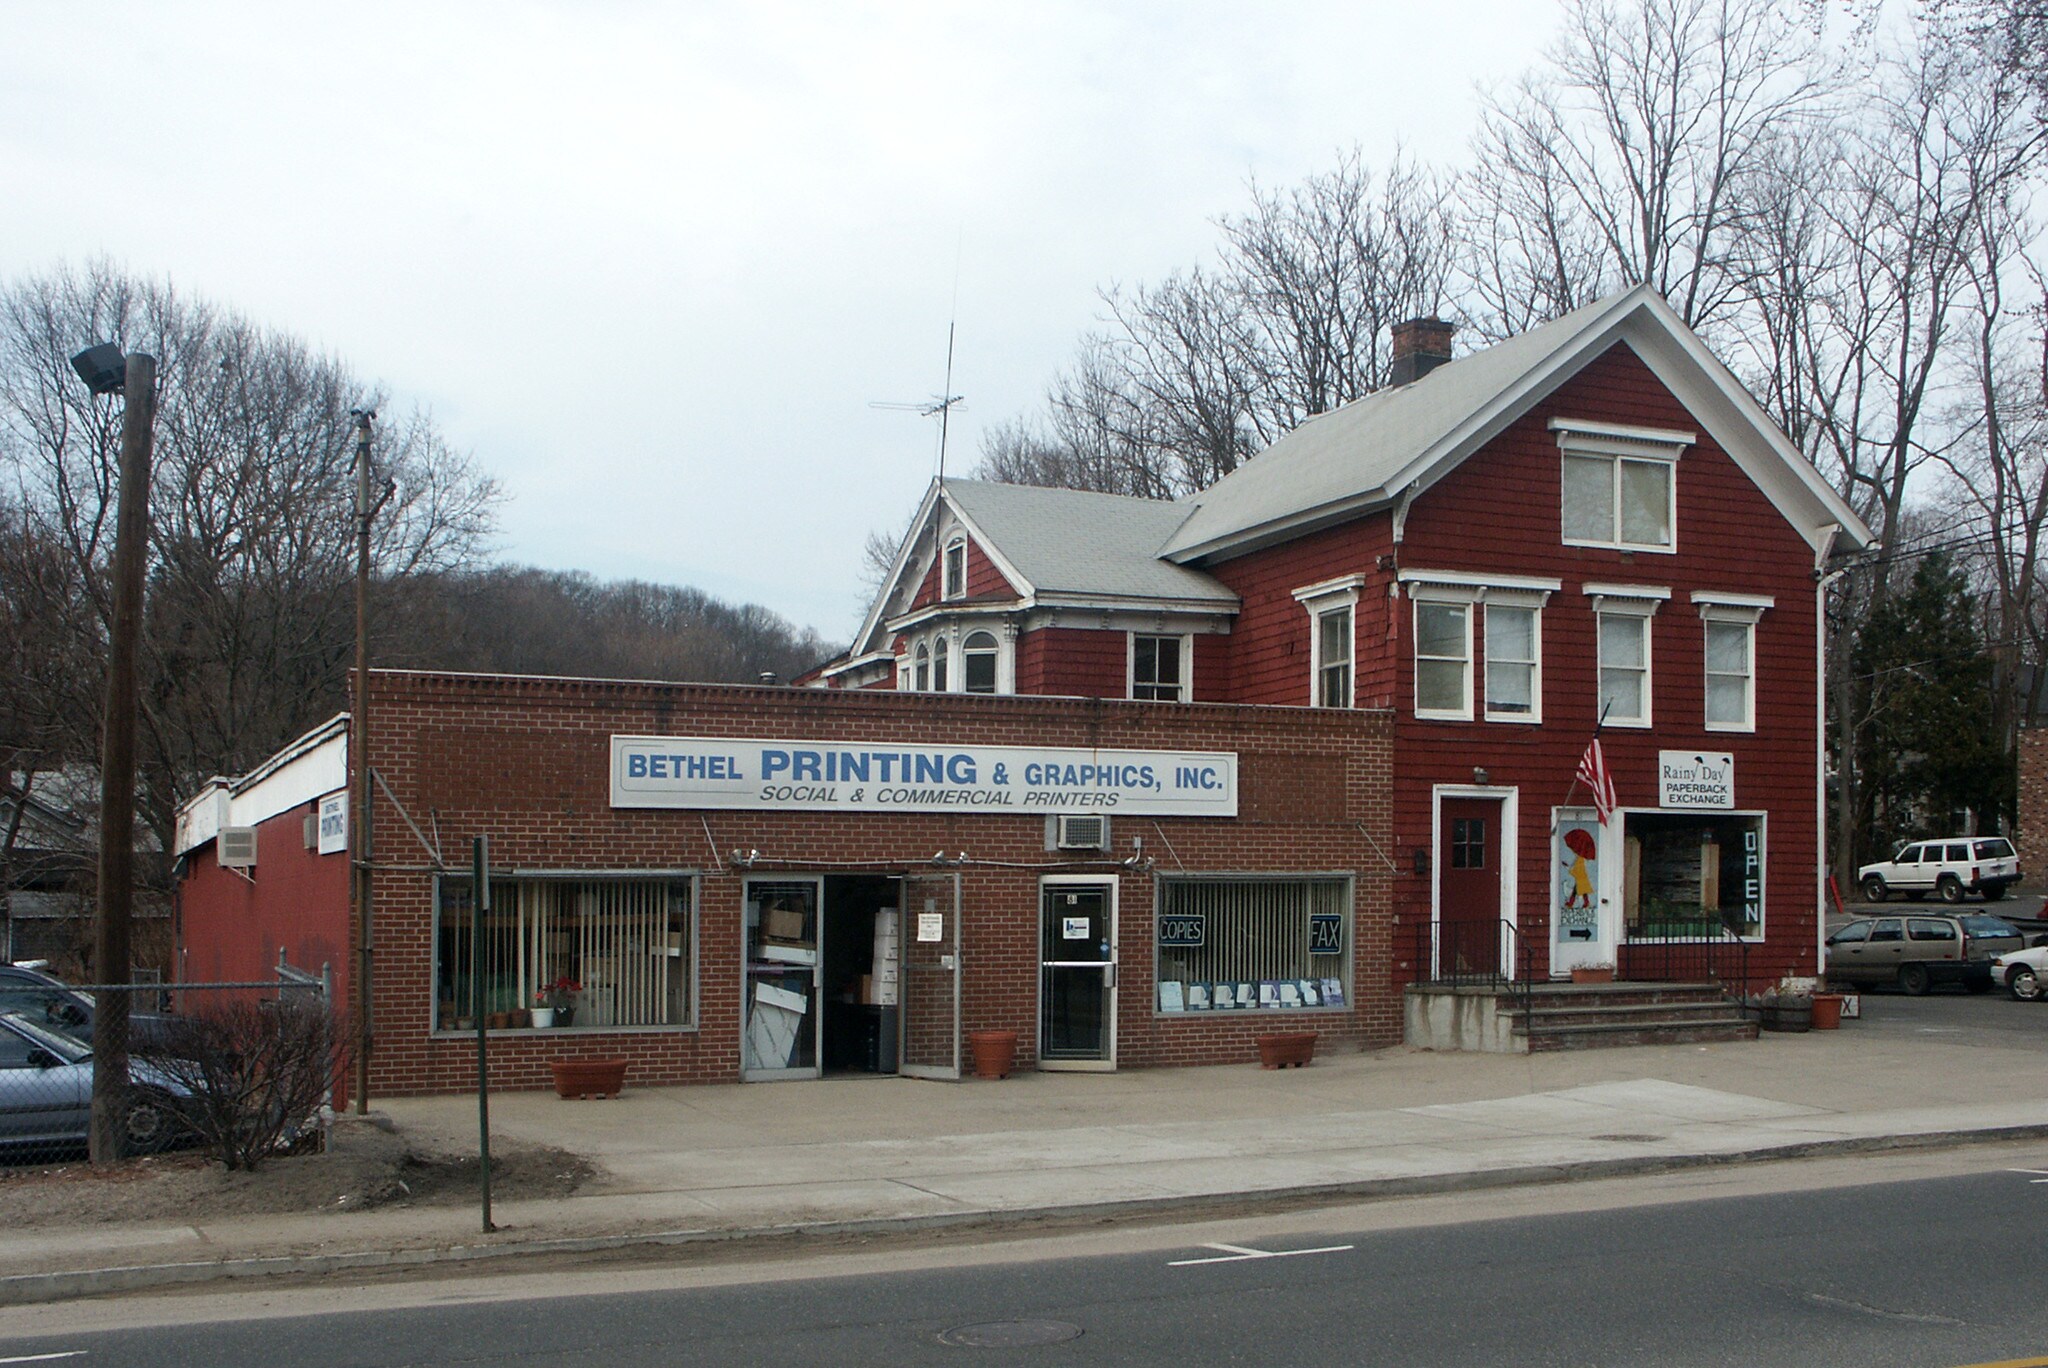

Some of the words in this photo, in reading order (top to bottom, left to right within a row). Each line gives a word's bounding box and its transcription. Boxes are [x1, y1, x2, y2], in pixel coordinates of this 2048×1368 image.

[628, 754, 743, 780] BETHEL
[761, 749, 977, 785] PRINTING
[992, 762, 1010, 785] &
[1024, 763, 1162, 792] GRAPHICS,
[1175, 767, 1223, 790] INC.
[1663, 765, 1698, 782] Rainy
[1702, 766, 1725, 783] Day
[759, 786, 838, 802] SOCIAL
[850, 788, 865, 802] &
[877, 788, 1014, 805] COMMERCIAL
[1023, 791, 1120, 807] PRINTERS
[1666, 783, 1728, 794] PAPERBACK
[1669, 794, 1727, 804] EXCHANGE
[1745, 831, 1759, 922] OPEN
[1159, 920, 1202, 940] COPIES
[1310, 920, 1340, 947] FAX
